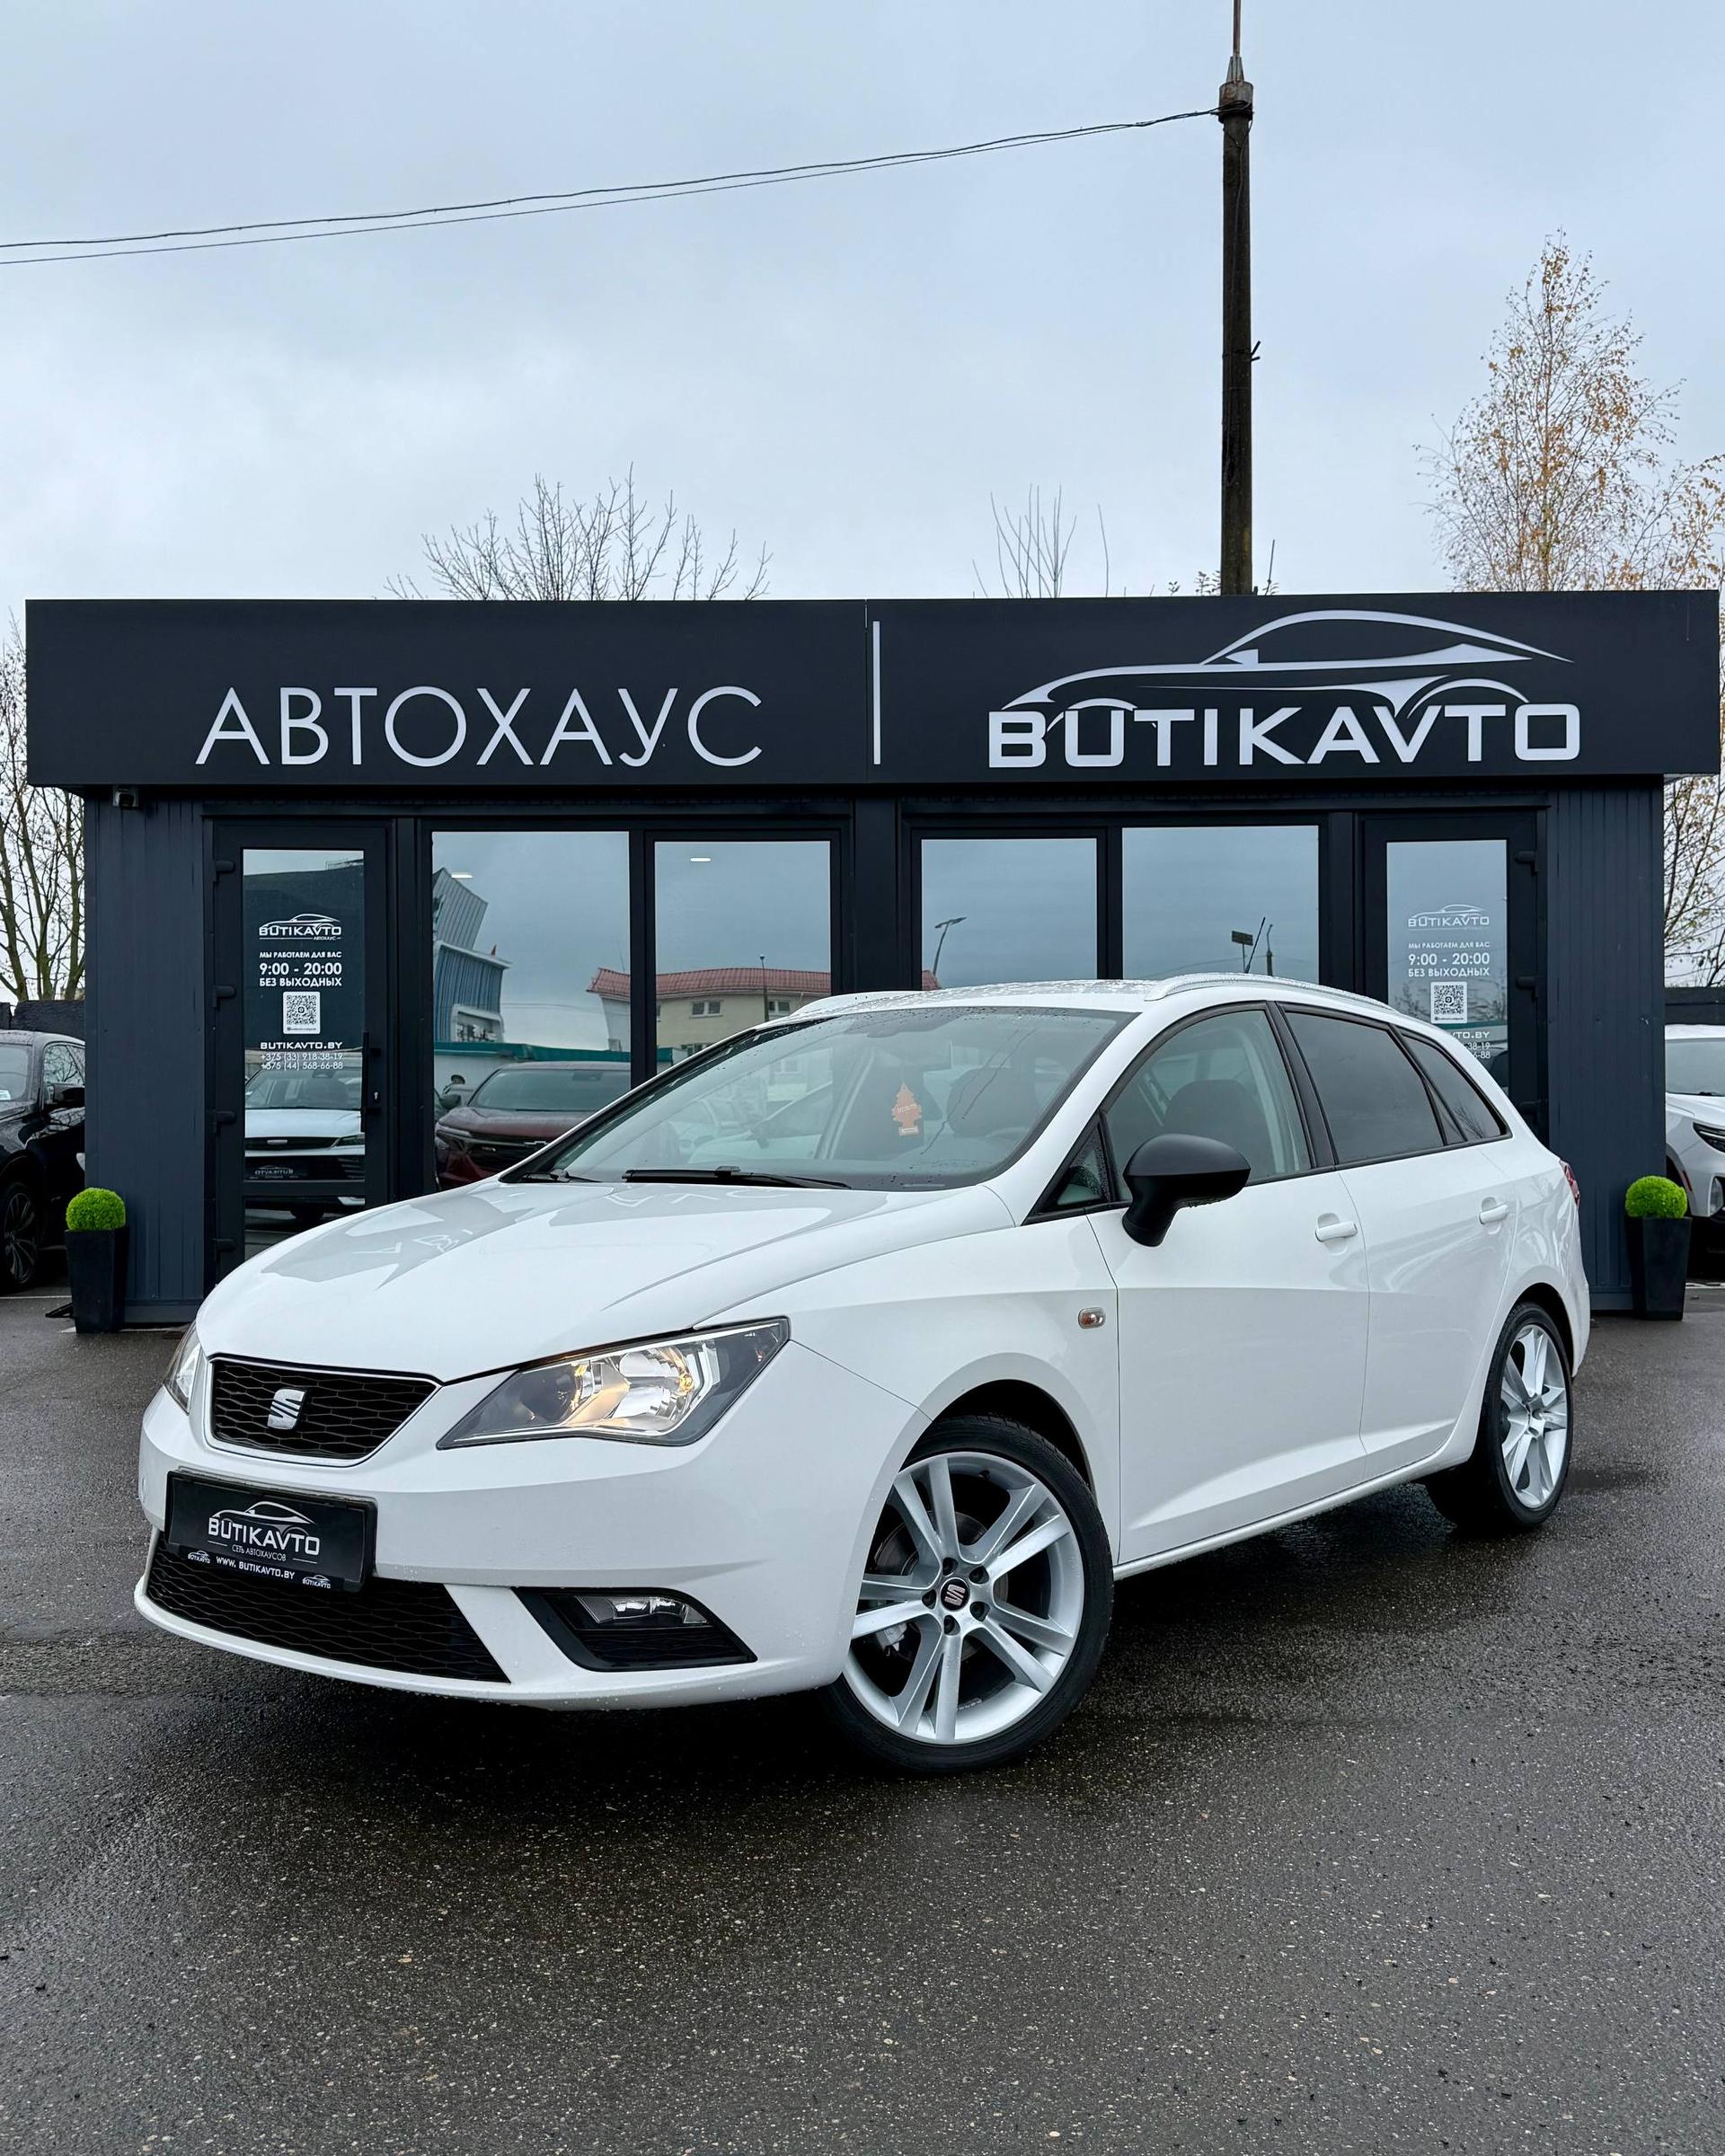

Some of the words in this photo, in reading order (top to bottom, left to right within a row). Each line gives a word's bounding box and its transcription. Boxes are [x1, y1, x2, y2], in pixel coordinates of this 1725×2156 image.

[195, 685, 763, 767] АВТОХАУС
[988, 703, 1580, 768] BUTIKAVTO
[1408, 916, 1490, 927] BUTIKAVTO
[259, 925, 341, 936] BUTIKAVTO
[1408, 953, 1438, 966] 9:00
[1452, 952, 1491, 965] 20:00
[259, 962, 289, 975] 9:00
[304, 962, 342, 975] 20:00
[1408, 968, 1425, 977] БЕЗ
[1428, 968, 1491, 977] ВЫХОДНЫХ
[259, 977, 277, 986] БЕЗ
[279, 976, 342, 987] ВЫХОДНЫХ
[260, 1041, 342, 1049] BUTIKAVTO.BY
[261, 1052, 281, 1061] +375
[284, 1052, 299, 1062] (33)
[302, 1052, 343, 1061] 918-38-19
[284, 1061, 299, 1071] (44)
[302, 1061, 343, 1070] 568-66-88
[208, 1516, 320, 1556] BUTIKAVTO
[232, 1544, 245, 1554] СЕТЬ
[245, 1547, 287, 1561] АВТОХАУСОВ
[238, 1560, 296, 1580] BUTIKAVTO.BY
